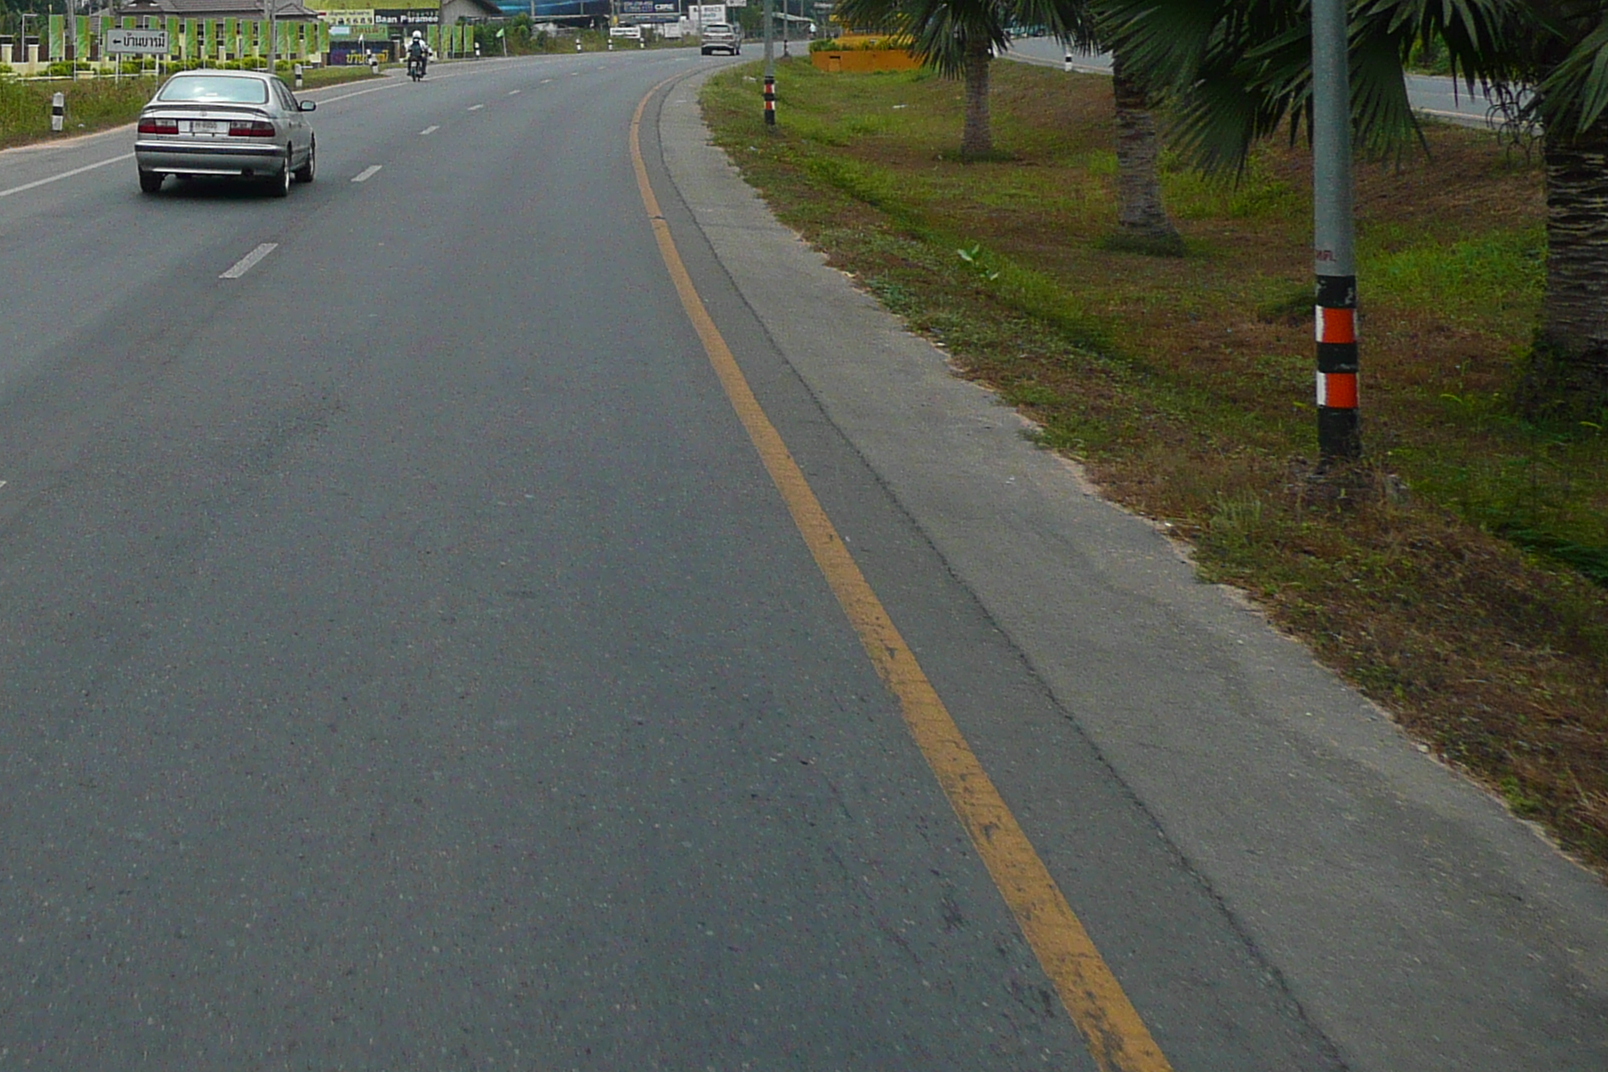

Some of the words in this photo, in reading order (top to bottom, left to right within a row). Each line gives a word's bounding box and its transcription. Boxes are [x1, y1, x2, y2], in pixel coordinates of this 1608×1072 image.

[375, 14, 398, 24] Baan
[123, 31, 165, 48] บ้านบารมี
